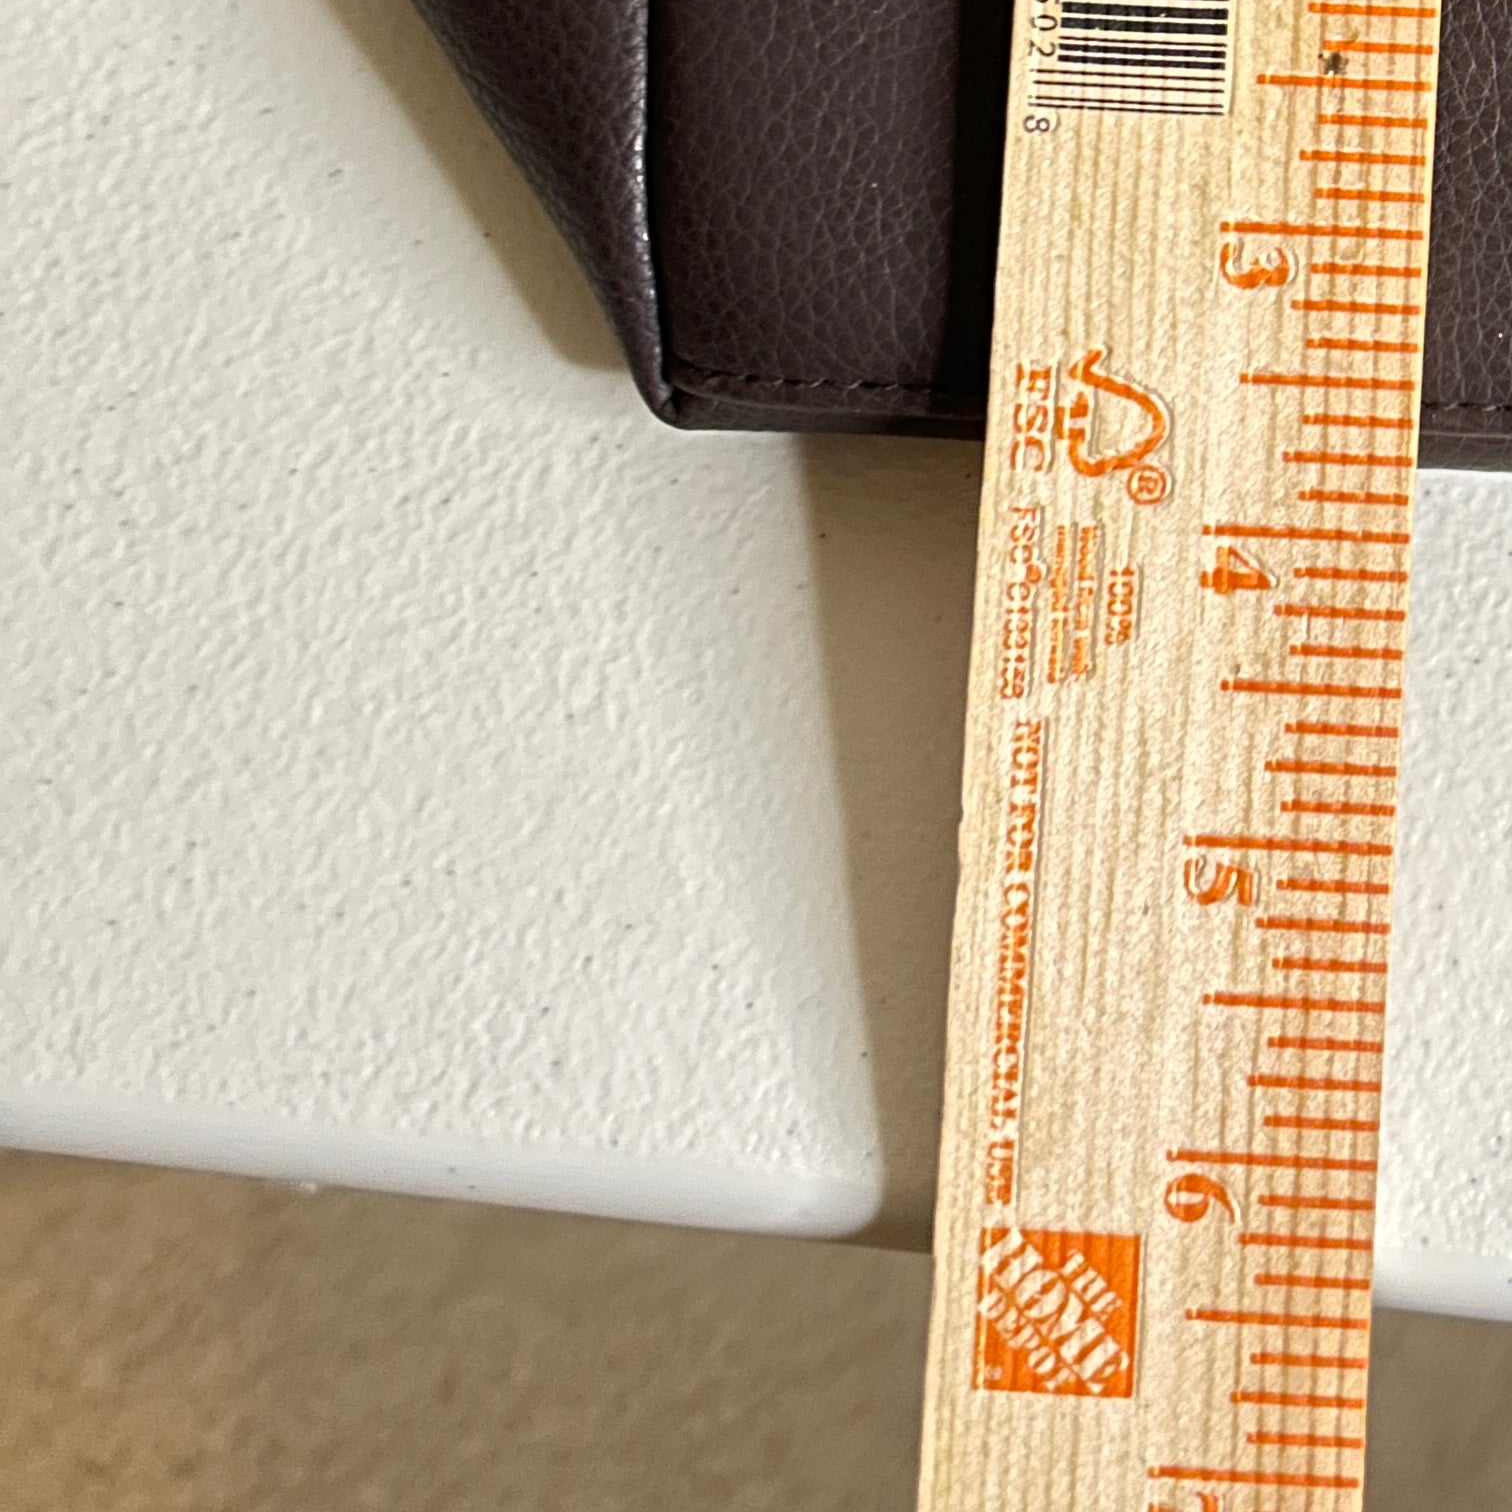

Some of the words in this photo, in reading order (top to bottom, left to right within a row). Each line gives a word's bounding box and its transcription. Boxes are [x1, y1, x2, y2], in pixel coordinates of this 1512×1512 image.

[1219, 242, 1290, 288] 3
[1008, 362, 1051, 472] FSC
[1199, 546, 1271, 595] 4
[1010, 719, 1041, 795] NOT
[1004, 802, 1037, 873] FOR
[1182, 858, 1252, 907] 5
[988, 882, 1030, 1130] COMMERCIAL
[985, 1139, 1014, 1206] USE
[1163, 1172, 1237, 1224] 6
[980, 1228, 1130, 1395] HOME
[1061, 1249, 1123, 1322] THE
[977, 1288, 1075, 1391] DEPOT
